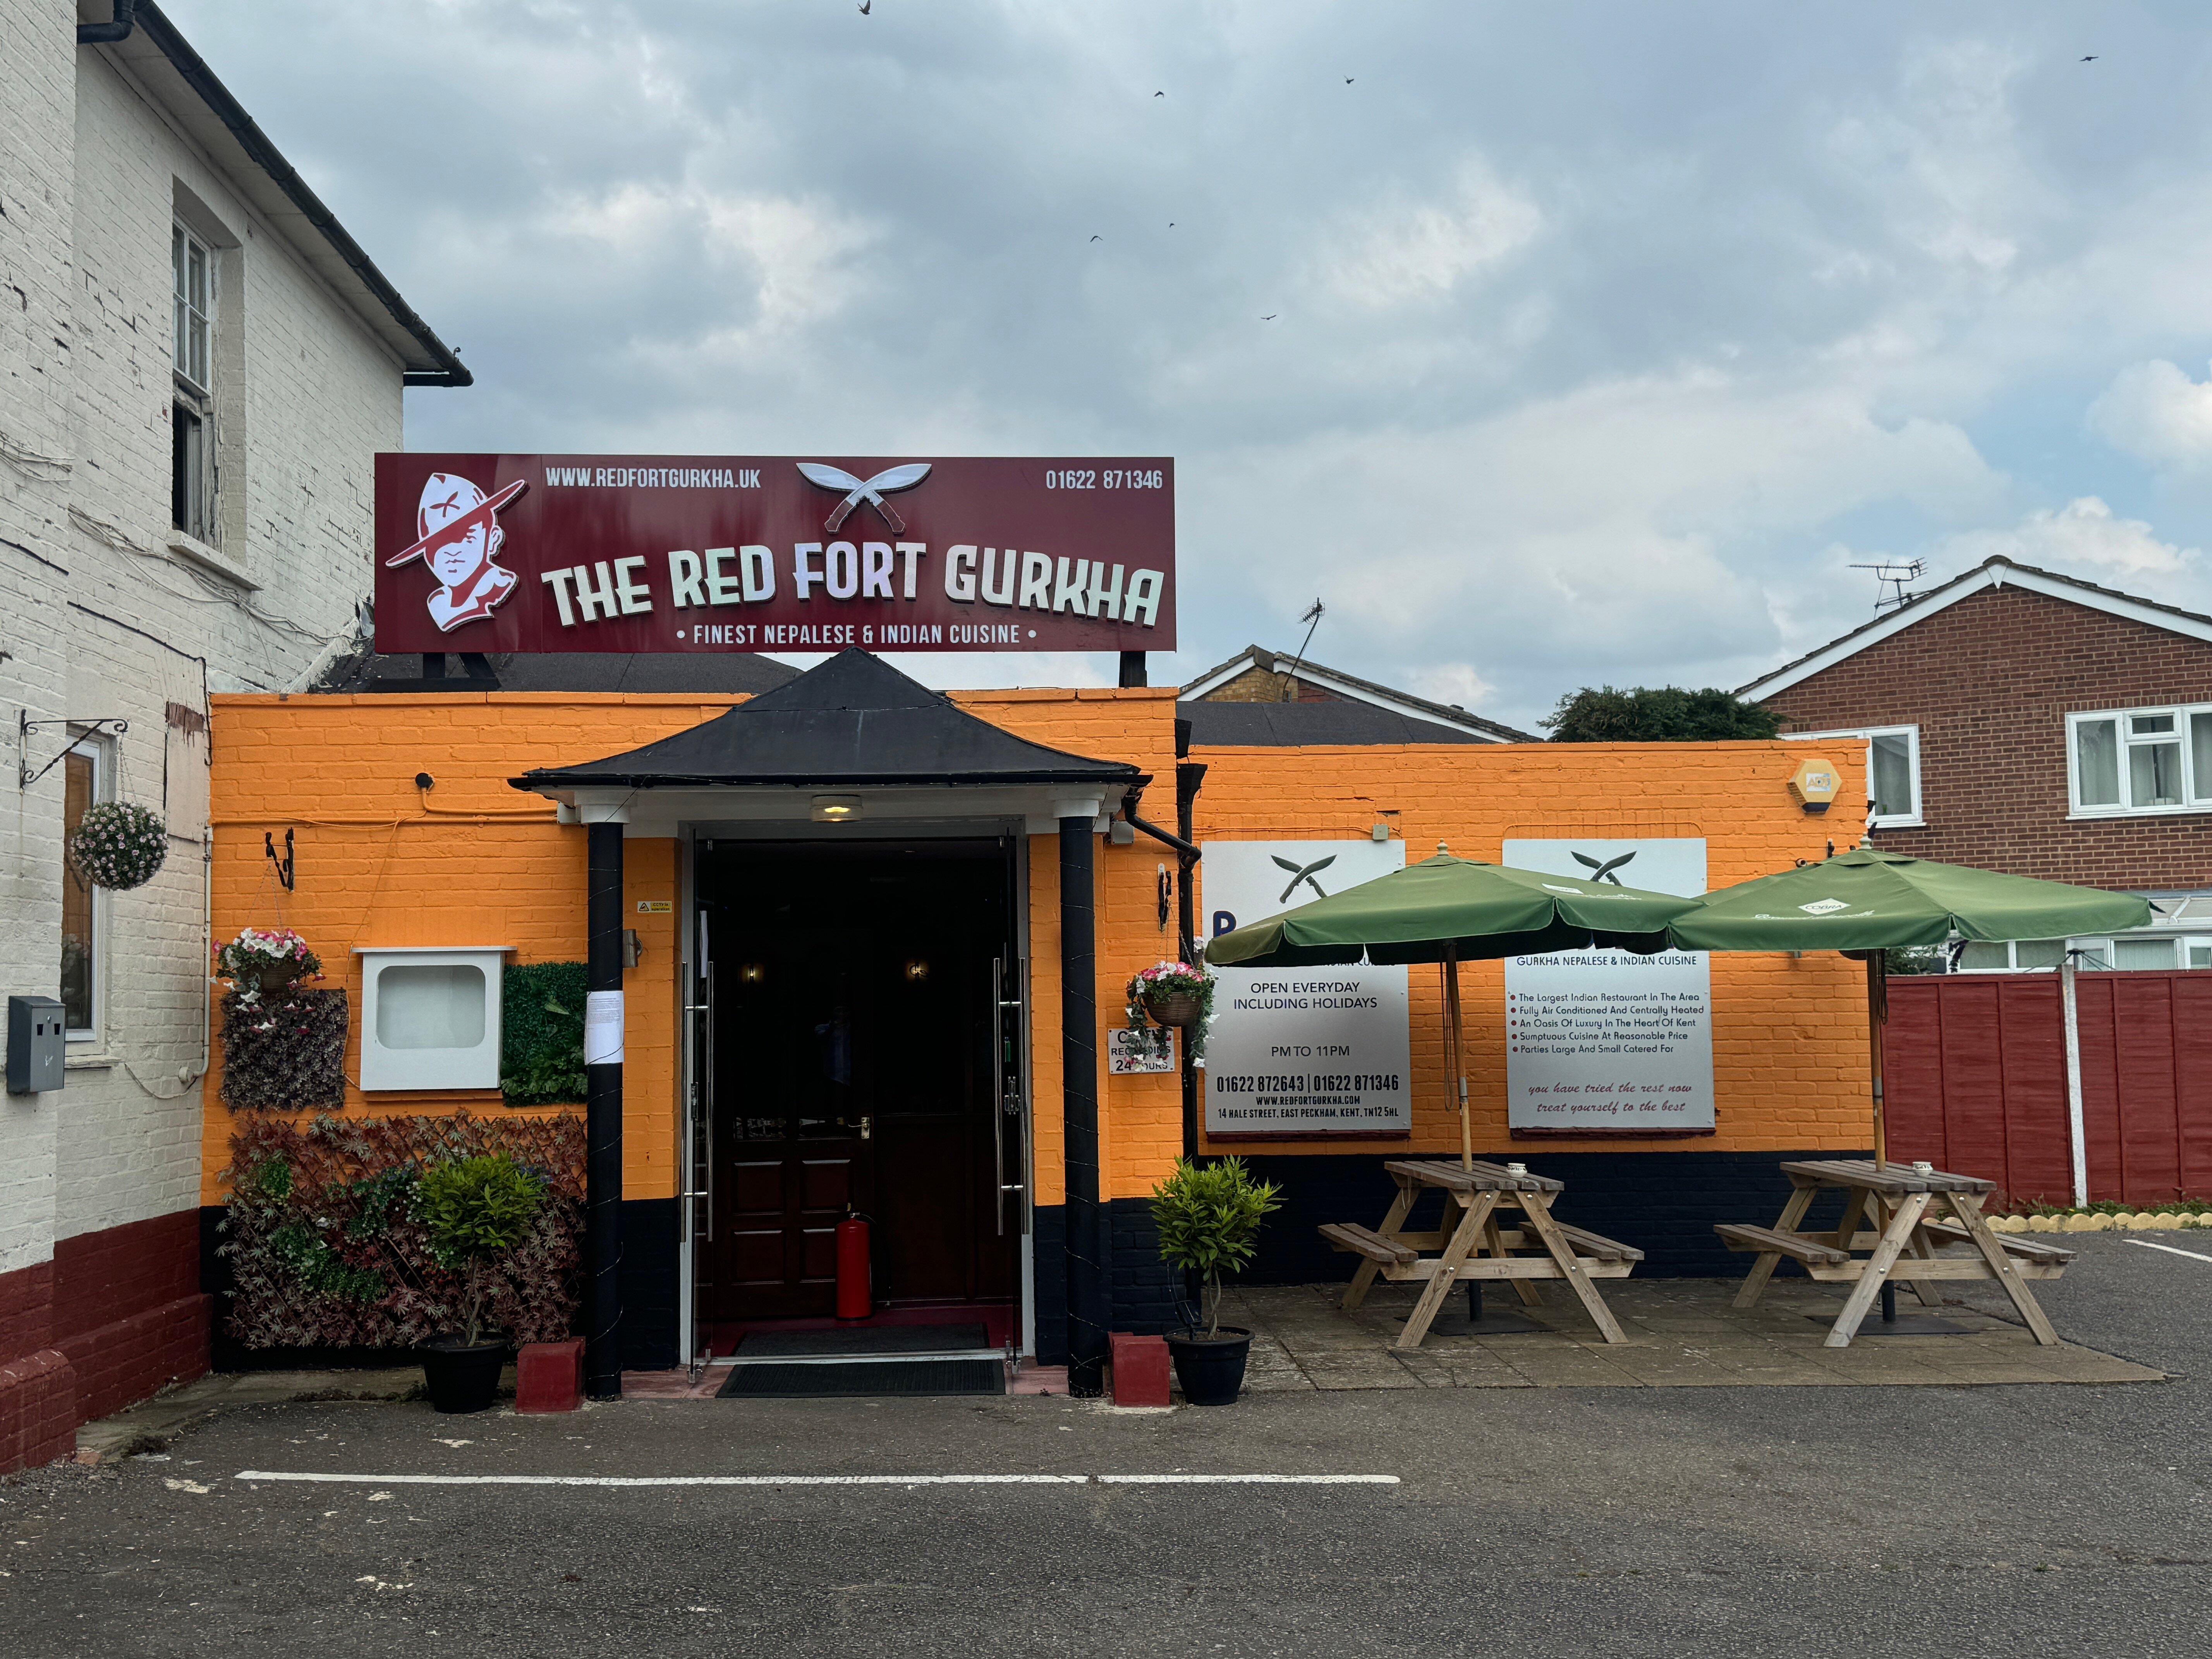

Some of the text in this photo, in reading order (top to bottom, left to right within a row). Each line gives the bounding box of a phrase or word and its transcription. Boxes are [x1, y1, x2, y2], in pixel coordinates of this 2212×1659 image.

[546, 467, 761, 488] WWW.REDFORTGURKHA.UK
[1046, 470, 1163, 489] 01622 871346
[541, 541, 1164, 628] THE RED FORT GURKHA
[694, 625, 1019, 644] FINEST NEPALESE & INDIAN CUISINE
[1517, 956, 1697, 966] GURKHA NEPALESE & INDIAN CUISINE
[1251, 982, 1360, 993] OPEN EVERYDAY
[1234, 997, 1377, 1009] INCLUDING HOLIDAYS
[1519, 992, 1699, 1003] The Largest Indian Restaurant In The Area
[1520, 1005, 1704, 1017] Fully Air Conditioned And Centrally Heated
[1520, 1018, 1696, 1029] An Oasis Of Luxury In The Heart Of Kent
[1520, 1031, 1688, 1044] Sumptuous Cuisine At Reasonable Price
[1272, 1046, 1350, 1057] PM TO 11PM
[1521, 1044, 1673, 1055] Parties Large And Small Catered For
[1116, 1060, 1131, 1071] 24
[1217, 1075, 1399, 1092] 01622 872643 01622 871346
[1529, 1086, 1549, 1096] you
[1554, 1082, 1580, 1092] have
[1585, 1083, 1614, 1092] tried
[1619, 1082, 1635, 1092] the
[1641, 1084, 1664, 1092] rest
[1256, 1096, 1360, 1106] WWW.REDFORTGURKHA.COM
[1218, 1107, 1399, 1119] 14 HALE STREET, EAST PECKHAM, KENT, TN12 5HL
[1537, 1100, 1686, 1115] treat yourself to the best
